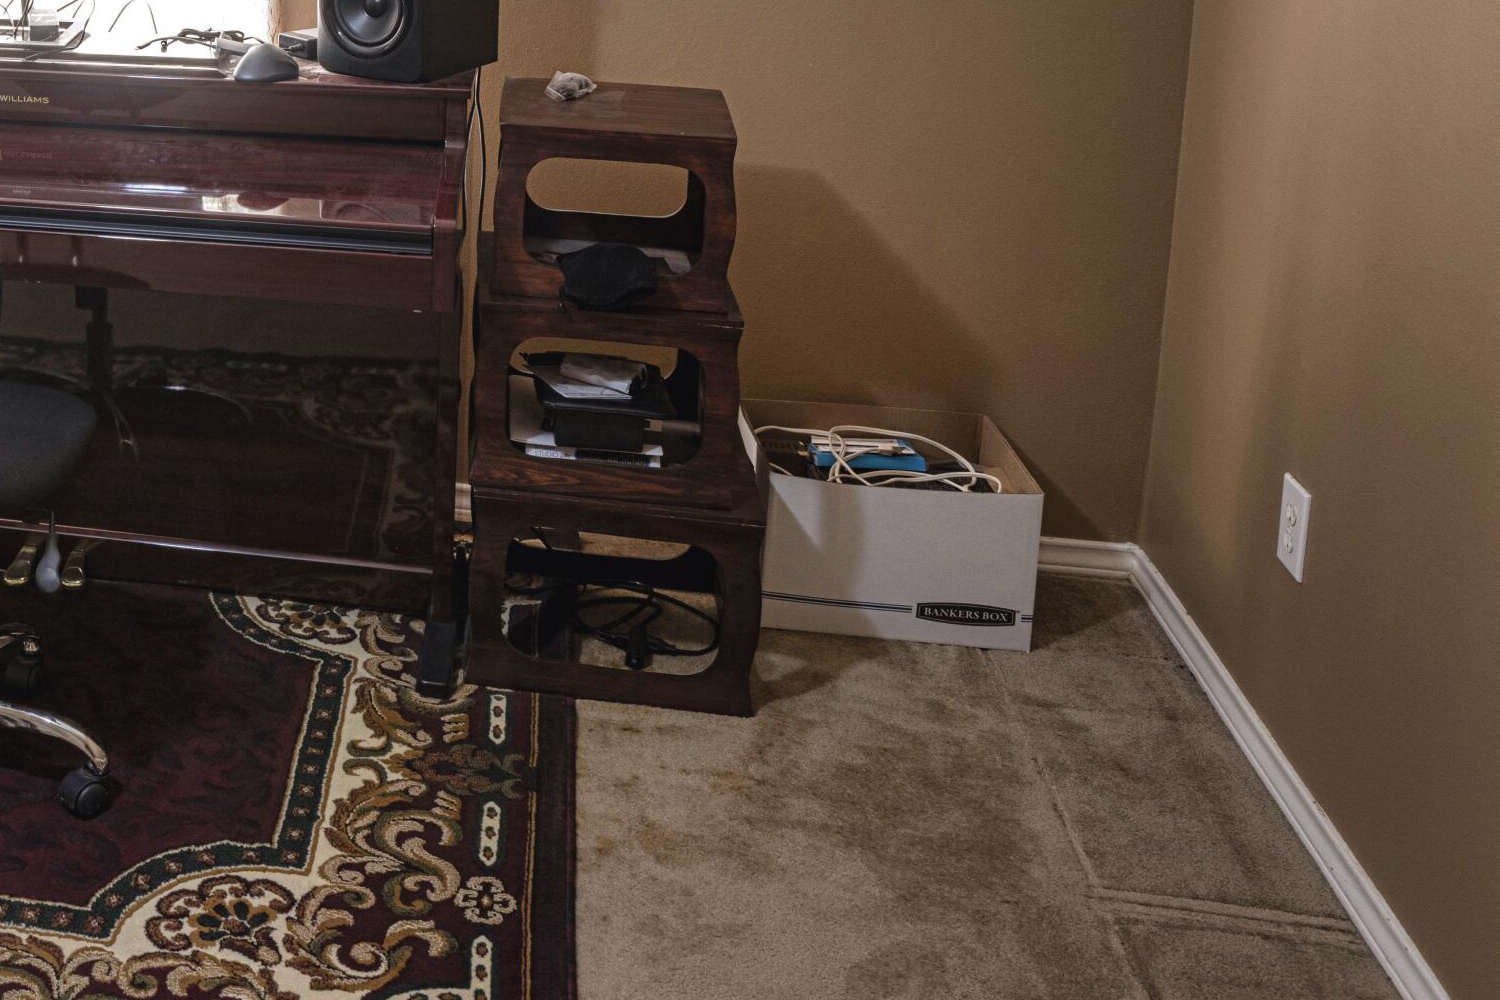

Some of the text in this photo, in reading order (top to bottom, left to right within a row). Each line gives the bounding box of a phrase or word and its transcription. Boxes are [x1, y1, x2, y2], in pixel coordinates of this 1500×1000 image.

[0, 94, 50, 104] WILLIAMS
[924, 607, 1008, 621] BANKERS BOX
